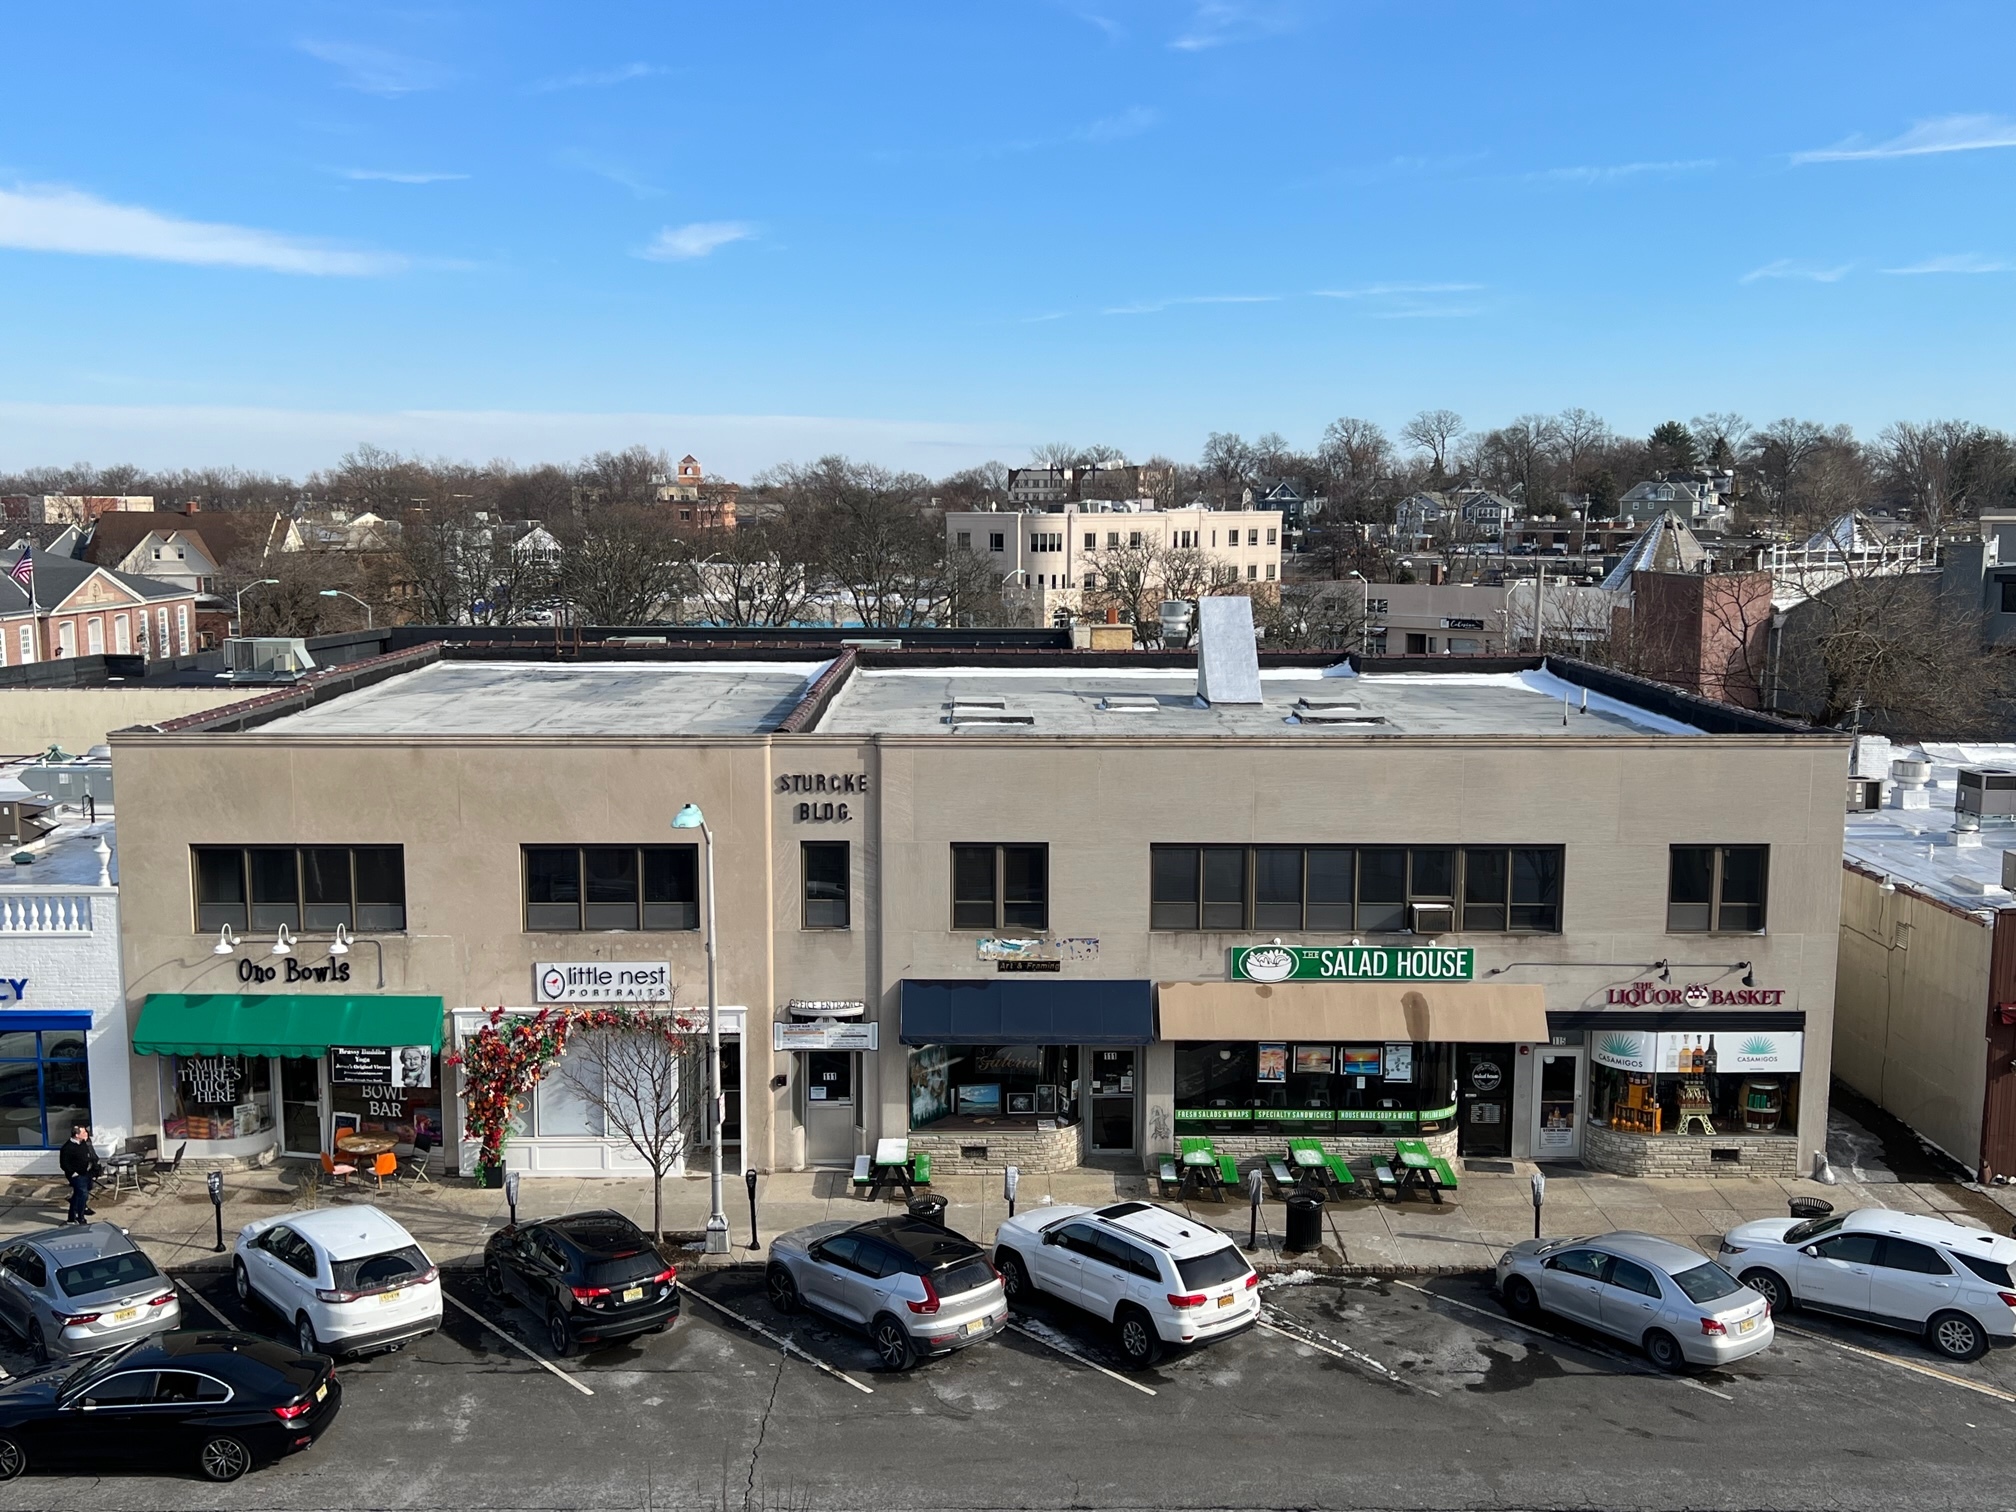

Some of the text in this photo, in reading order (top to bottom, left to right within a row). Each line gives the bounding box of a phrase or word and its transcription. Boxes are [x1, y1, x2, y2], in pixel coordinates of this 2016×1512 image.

[781, 774, 867, 792] STURCKE
[240, 956, 350, 983] Ono Bowls
[1026, 962, 1060, 971] Framing
[1321, 950, 1388, 976] SALAD
[1397, 951, 1467, 976] HOUSE
[568, 966, 666, 985] little nest
[570, 988, 665, 997] PORTRAITS
[1608, 988, 1785, 1006] LIQUOR BASKET
[1104, 1052, 1117, 1060] 111
[1599, 1053, 1643, 1068] CASAMIGOS
[178, 1068, 241, 1081] THERE'S
[823, 1072, 836, 1080] 111
[192, 1080, 235, 1096] JUICE
[362, 1085, 408, 1101] BOWL
[198, 1091, 236, 1103] HERE
[369, 1101, 402, 1117] BAR
[1292, 1111, 1332, 1119] SANDWICHES
